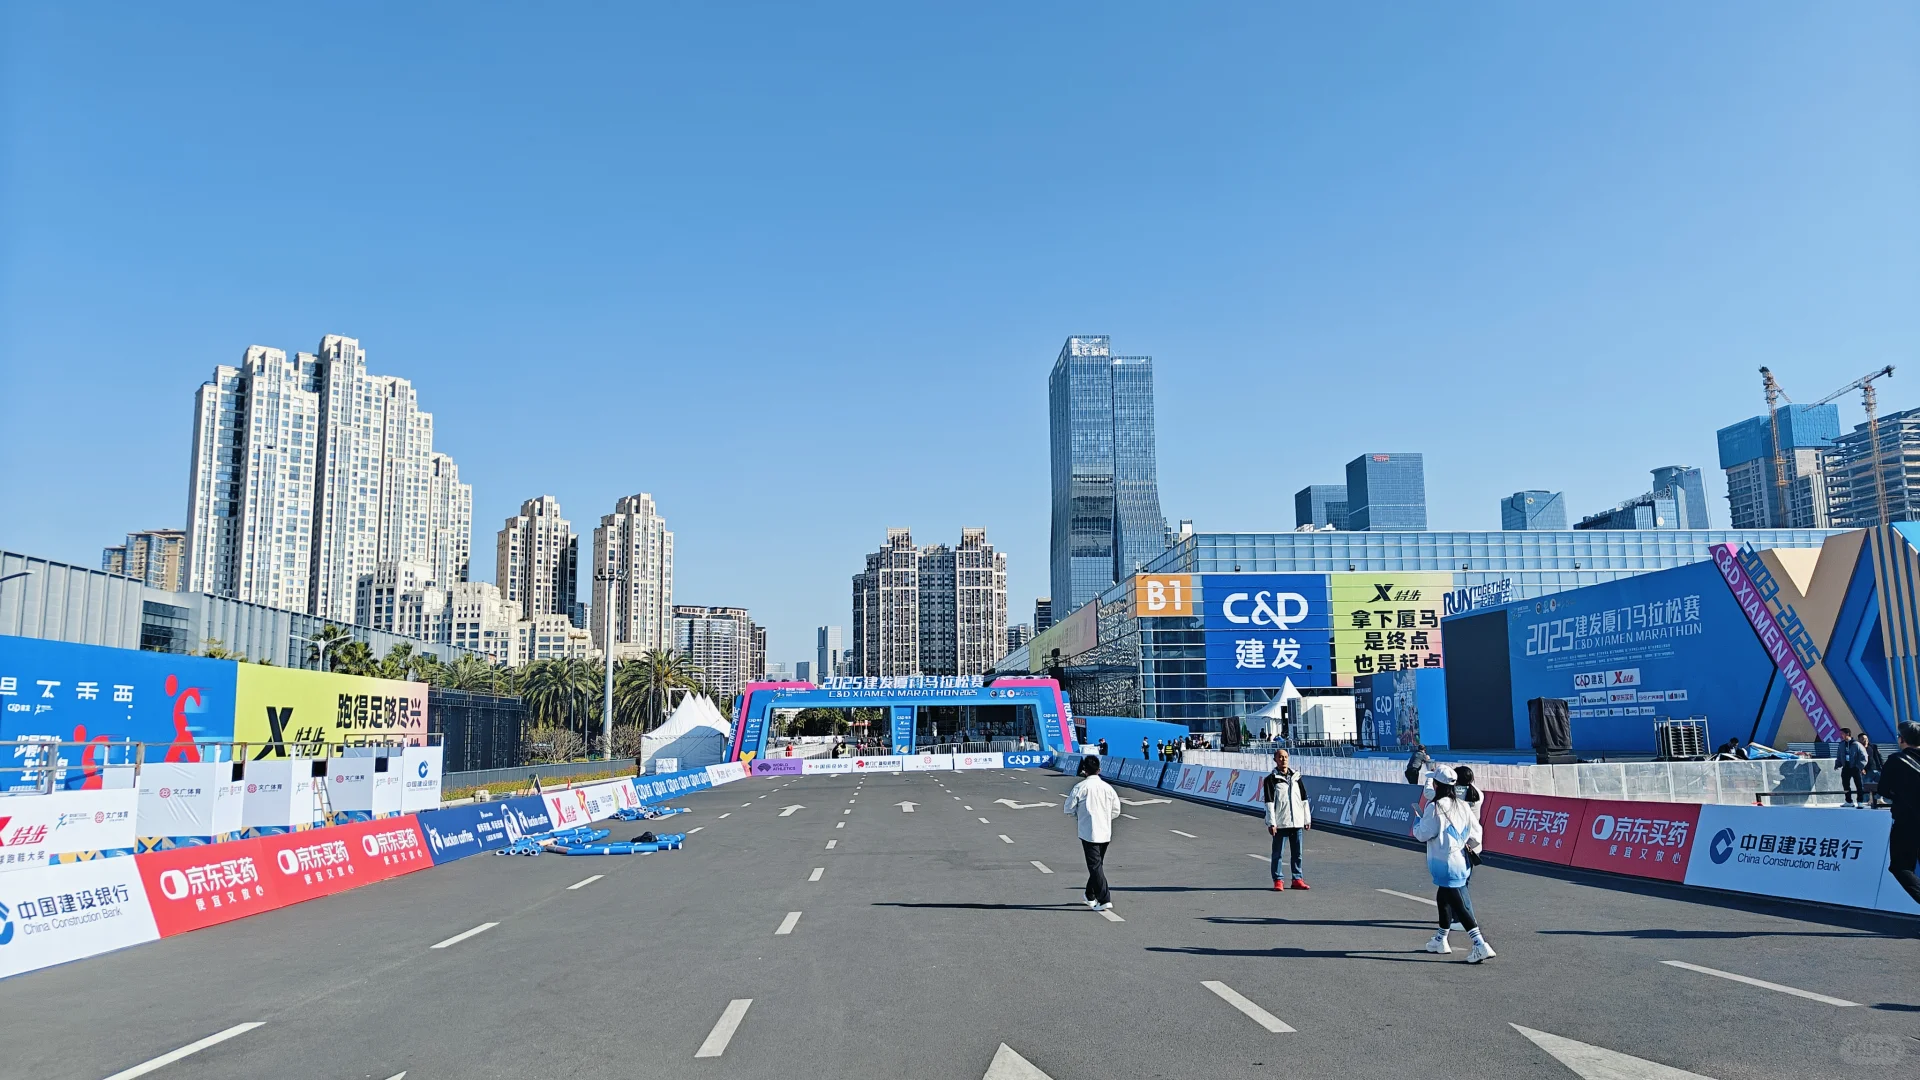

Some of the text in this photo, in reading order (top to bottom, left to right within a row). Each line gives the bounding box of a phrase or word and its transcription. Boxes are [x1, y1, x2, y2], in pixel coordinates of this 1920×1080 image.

[1146, 580, 1182, 611] B1
[1474, 578, 1510, 598] TOGETHER
[1222, 590, 1309, 630] C&D
[1443, 587, 1474, 616] RUN
[1715, 546, 1741, 585] C&D
[1737, 582, 1788, 663] XIAMEN
[1736, 541, 1822, 671] 2003-2025
[1351, 609, 1438, 628] 拿下厦马
[1364, 631, 1429, 651] 是终点
[1575, 622, 1702, 650] C&D XIAMEN MARATHON
[1235, 637, 1302, 669] 建发
[1354, 653, 1441, 673] 也是起点
[822, 675, 985, 690] 2025建发厦门马拉松赛
[828, 690, 850, 698] C&D
[853, 689, 895, 698] XIAMEN
[336, 693, 422, 729] 跑得足够尽兴
[1008, 754, 1050, 765] C&D 建发
[106, 811, 128, 819] 文广体育
[1375, 804, 1410, 821] luckin coffee
[1511, 808, 1570, 836] 京东买药
[7, 824, 48, 847] 特步
[376, 828, 418, 854] 京东买药
[441, 832, 459, 848] luckin
[457, 829, 475, 846] coffee
[1507, 831, 1563, 849] 便宜又放心
[1613, 816, 1690, 848] 京东买药
[296, 840, 350, 871] 京东买药
[1608, 844, 1681, 865] 便宜又放心
[1739, 833, 1864, 860] 中国建设银行
[303, 864, 355, 885] 便宜又放心
[1737, 852, 1841, 872] China Construction Bank
[185, 856, 259, 895] 京东买药
[18, 884, 129, 920] 中国建设银行
[195, 884, 264, 912] 便宜又放心
[23, 906, 123, 936] China Construction Bank
